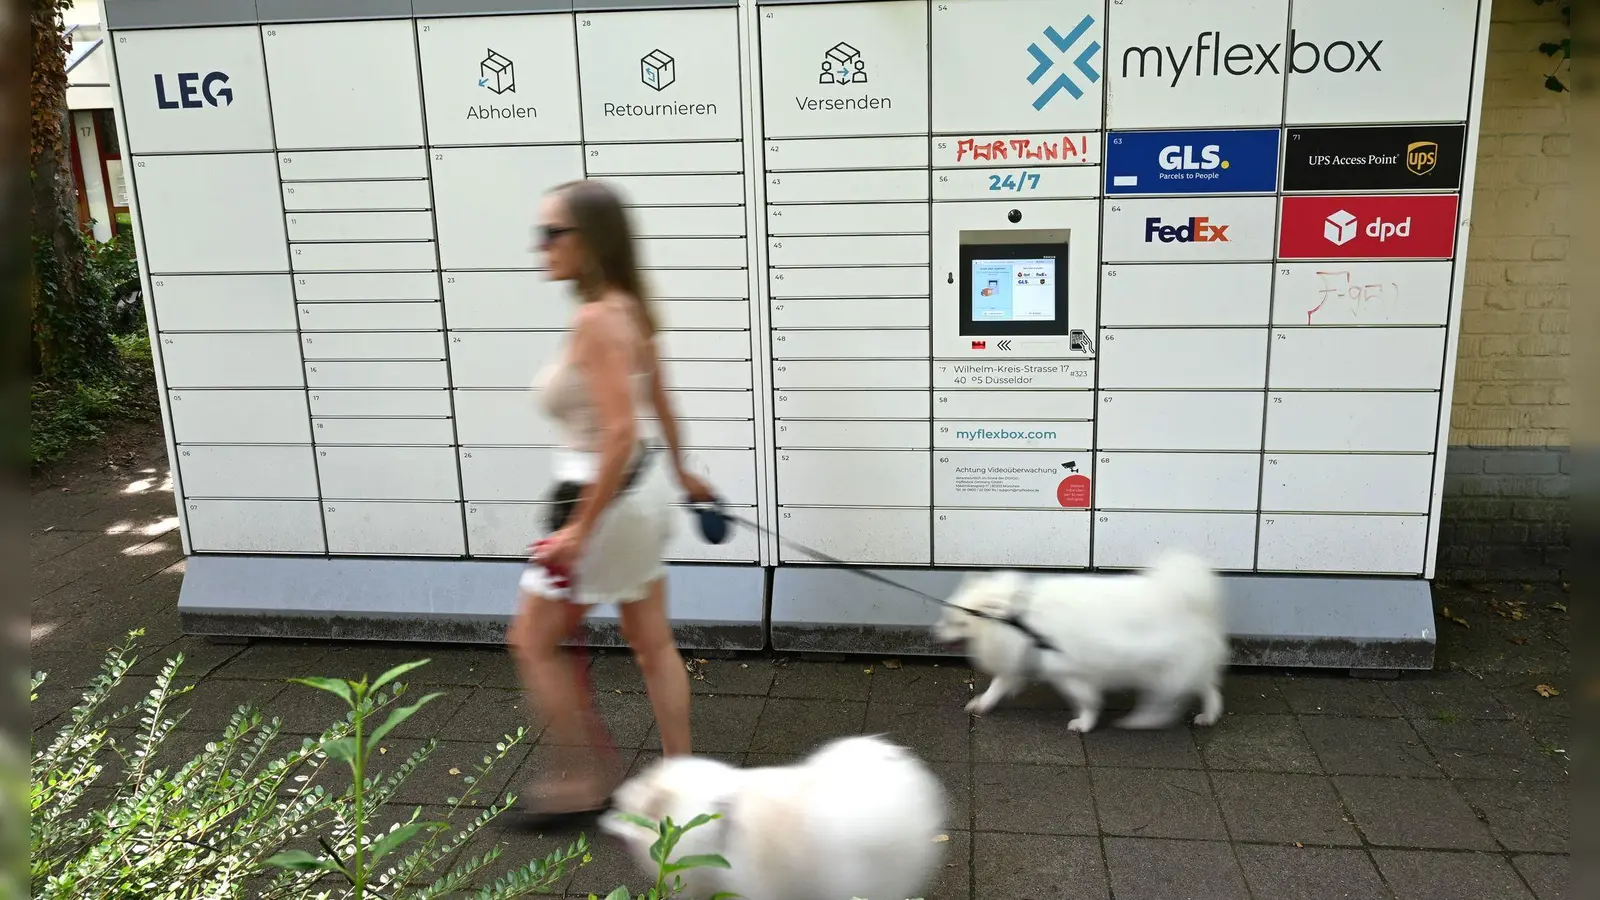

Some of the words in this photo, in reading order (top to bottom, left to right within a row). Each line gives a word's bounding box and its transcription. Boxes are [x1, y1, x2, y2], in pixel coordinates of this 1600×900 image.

[1122, 29, 1383, 87] myflexbox
[154, 71, 233, 109] LEG
[604, 101, 717, 117] Retournieren
[795, 95, 891, 111] Versenden
[467, 104, 537, 119] Abholen
[81, 127, 91, 137] 17
[1309, 155, 1330, 165] UPS
[1332, 155, 1366, 165] Access
[1409, 152, 1434, 170] ups
[989, 171, 1041, 192] 24/7
[1195, 172, 1219, 180] People
[1145, 217, 1229, 242] FedEx
[1366, 217, 1411, 242] dpd
[954, 365, 1058, 373] Wilhelm-Kreis-Strasse
[1060, 365, 1069, 373] 17
[956, 429, 1056, 441] myflexbox.com
